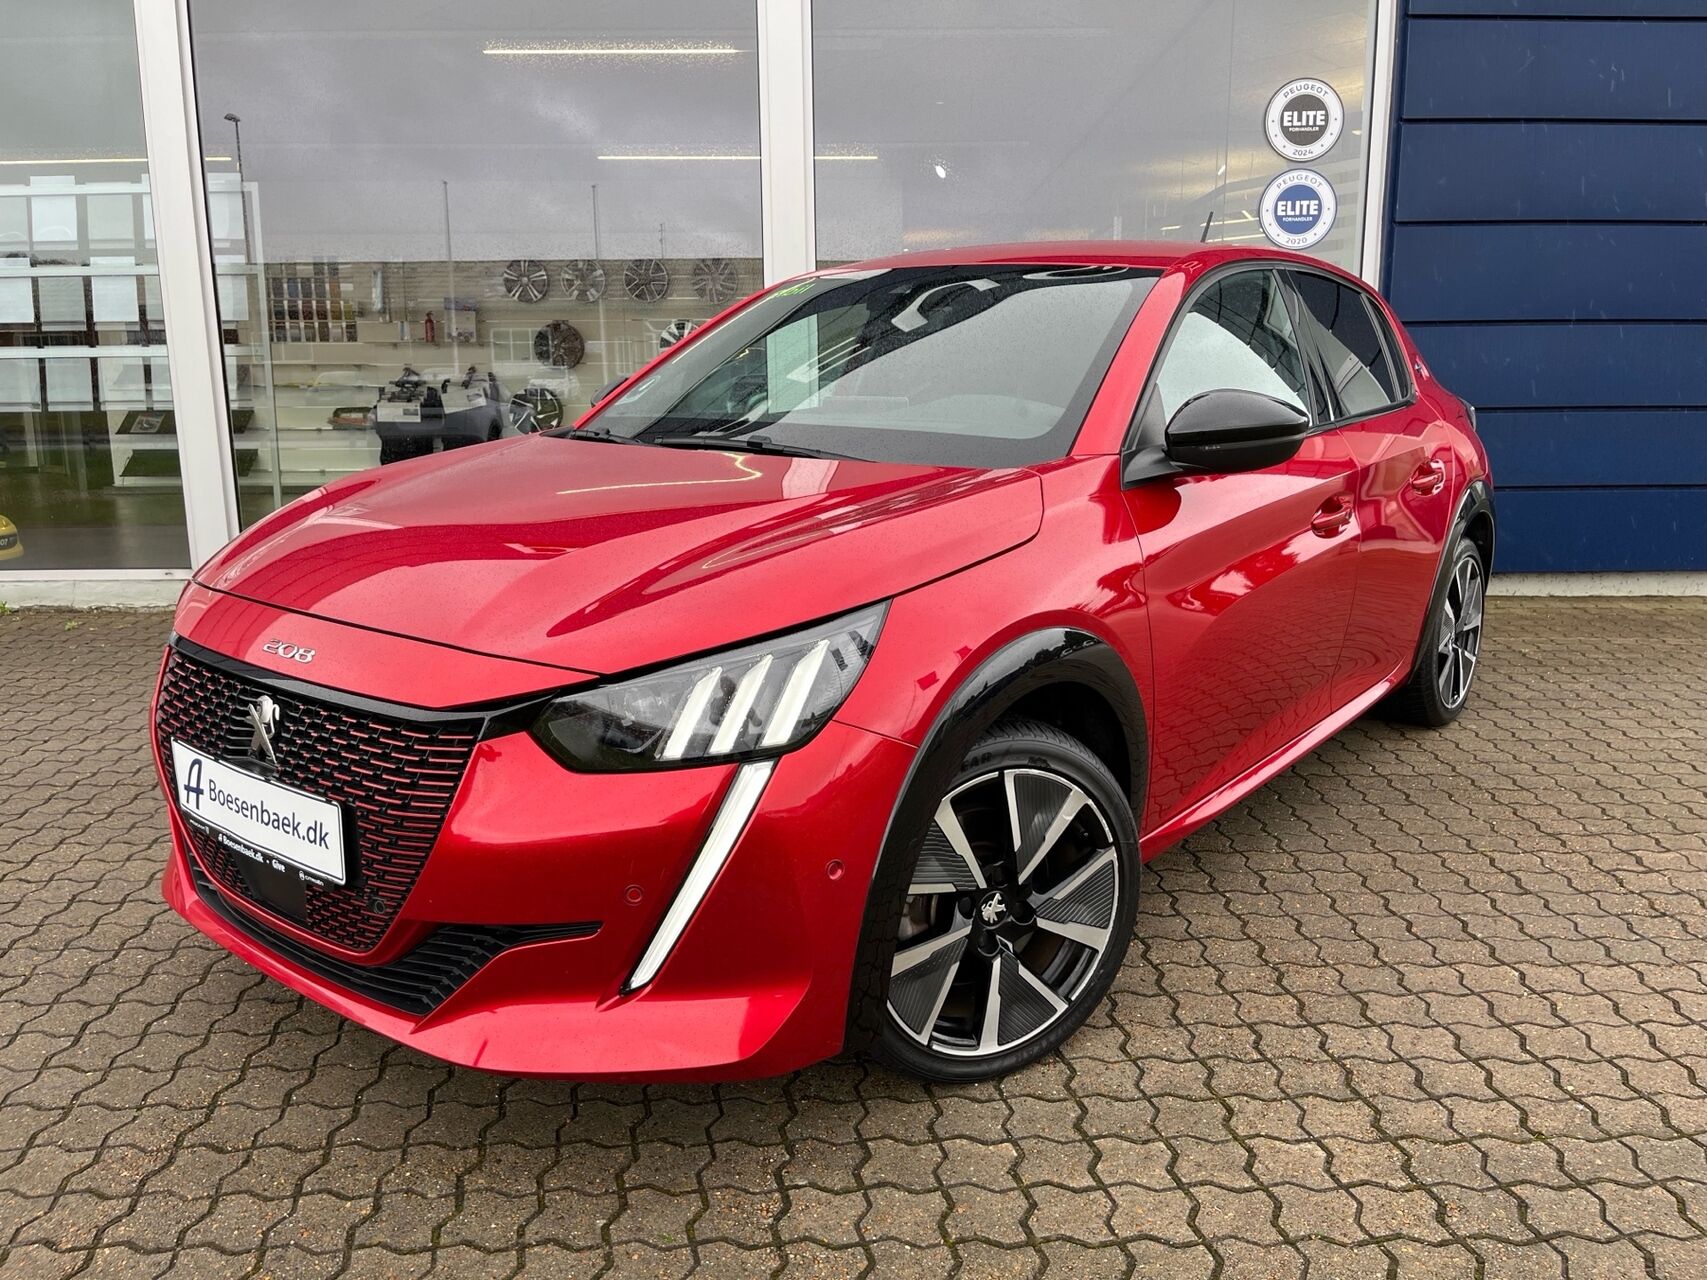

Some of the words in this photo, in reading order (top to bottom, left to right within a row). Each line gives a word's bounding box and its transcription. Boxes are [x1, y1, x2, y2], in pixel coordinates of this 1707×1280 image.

[1283, 83, 1329, 98] PEUGEOT
[1283, 110, 1326, 126] ELITE
[1276, 174, 1323, 190] PEUGEOT
[1276, 200, 1319, 216] ELITE
[1285, 237, 1308, 245] 2020
[262, 638, 316, 663] 208
[208, 778, 330, 850] Boesenbaek.dk
